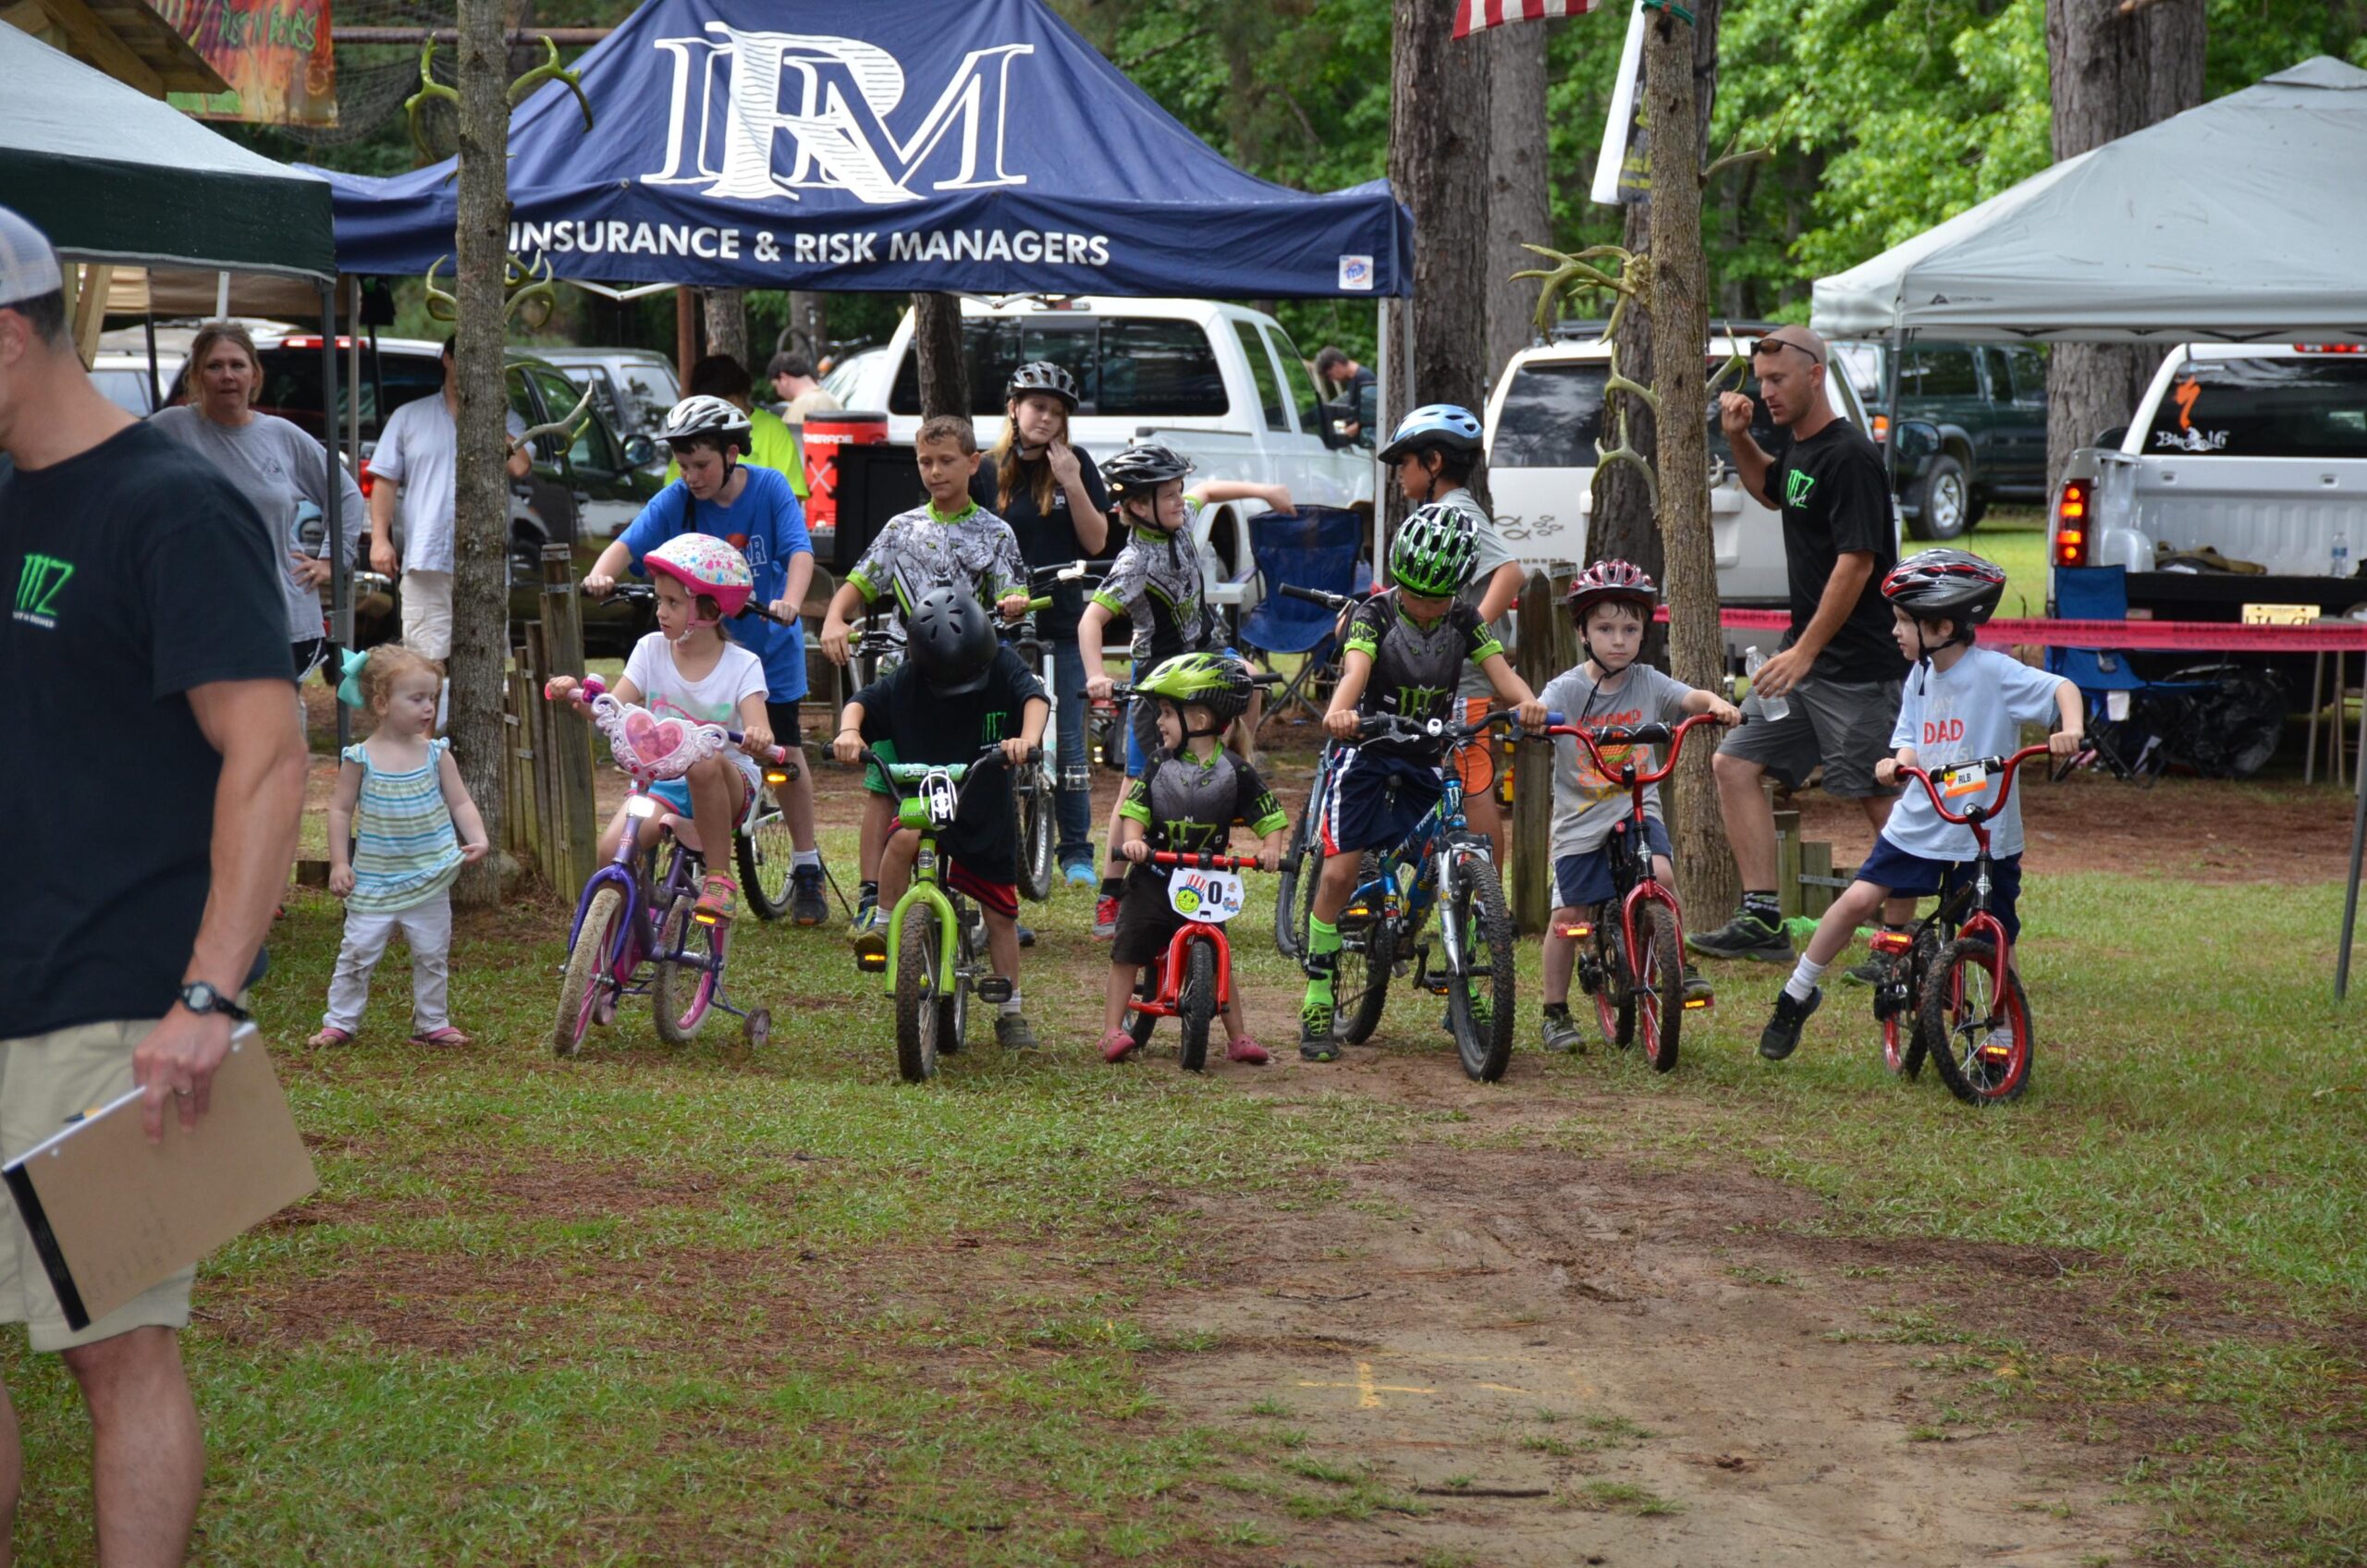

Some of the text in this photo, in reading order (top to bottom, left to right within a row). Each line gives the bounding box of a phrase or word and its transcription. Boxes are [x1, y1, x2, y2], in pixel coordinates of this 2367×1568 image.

[509, 220, 1110, 266] INSURANCE & RISK MANAGERS
[1923, 718, 1965, 745] DAD
